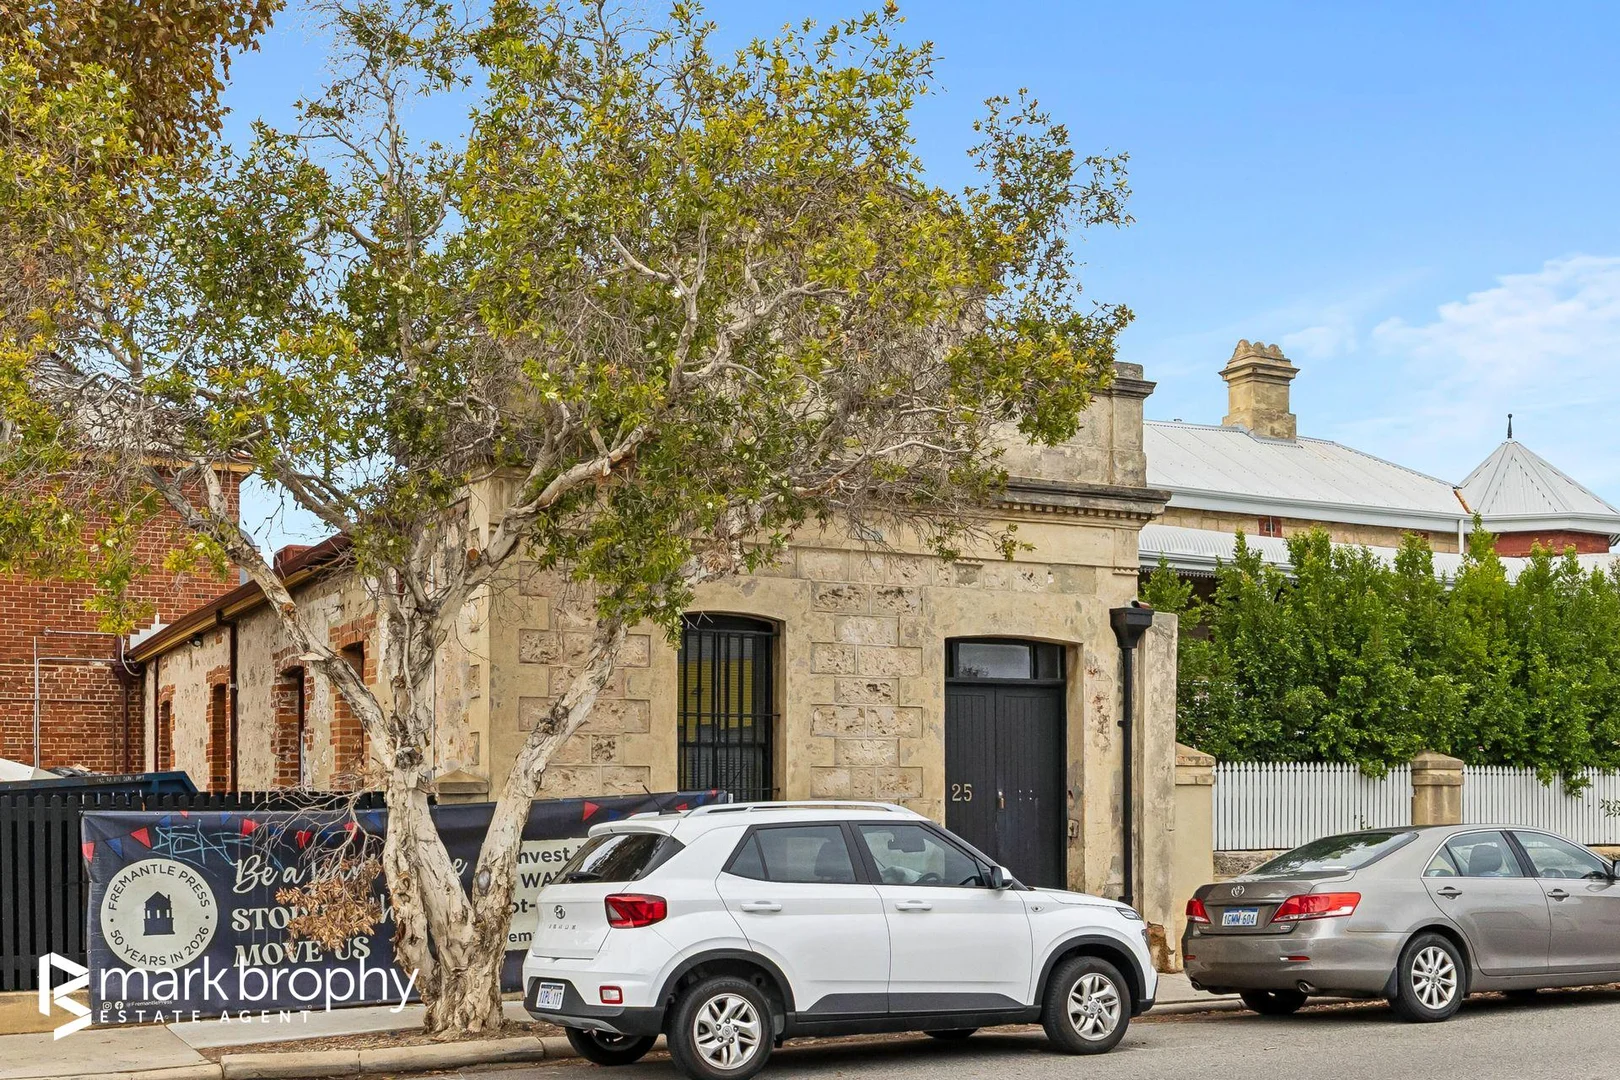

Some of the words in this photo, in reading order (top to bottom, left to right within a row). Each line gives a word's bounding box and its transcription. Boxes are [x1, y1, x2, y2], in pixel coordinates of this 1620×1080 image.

[951, 783, 973, 802] 25
[517, 847, 571, 864] nvest
[108, 863, 176, 911] FREMANTLE
[178, 870, 210, 908] PRESS
[232, 854, 279, 894] Be
[110, 929, 125, 946] 50
[123, 944, 167, 966] YEARS
[169, 950, 184, 964] IN
[183, 926, 209, 956] 2026
[232, 940, 323, 967] MOVE
[333, 936, 371, 961] US
